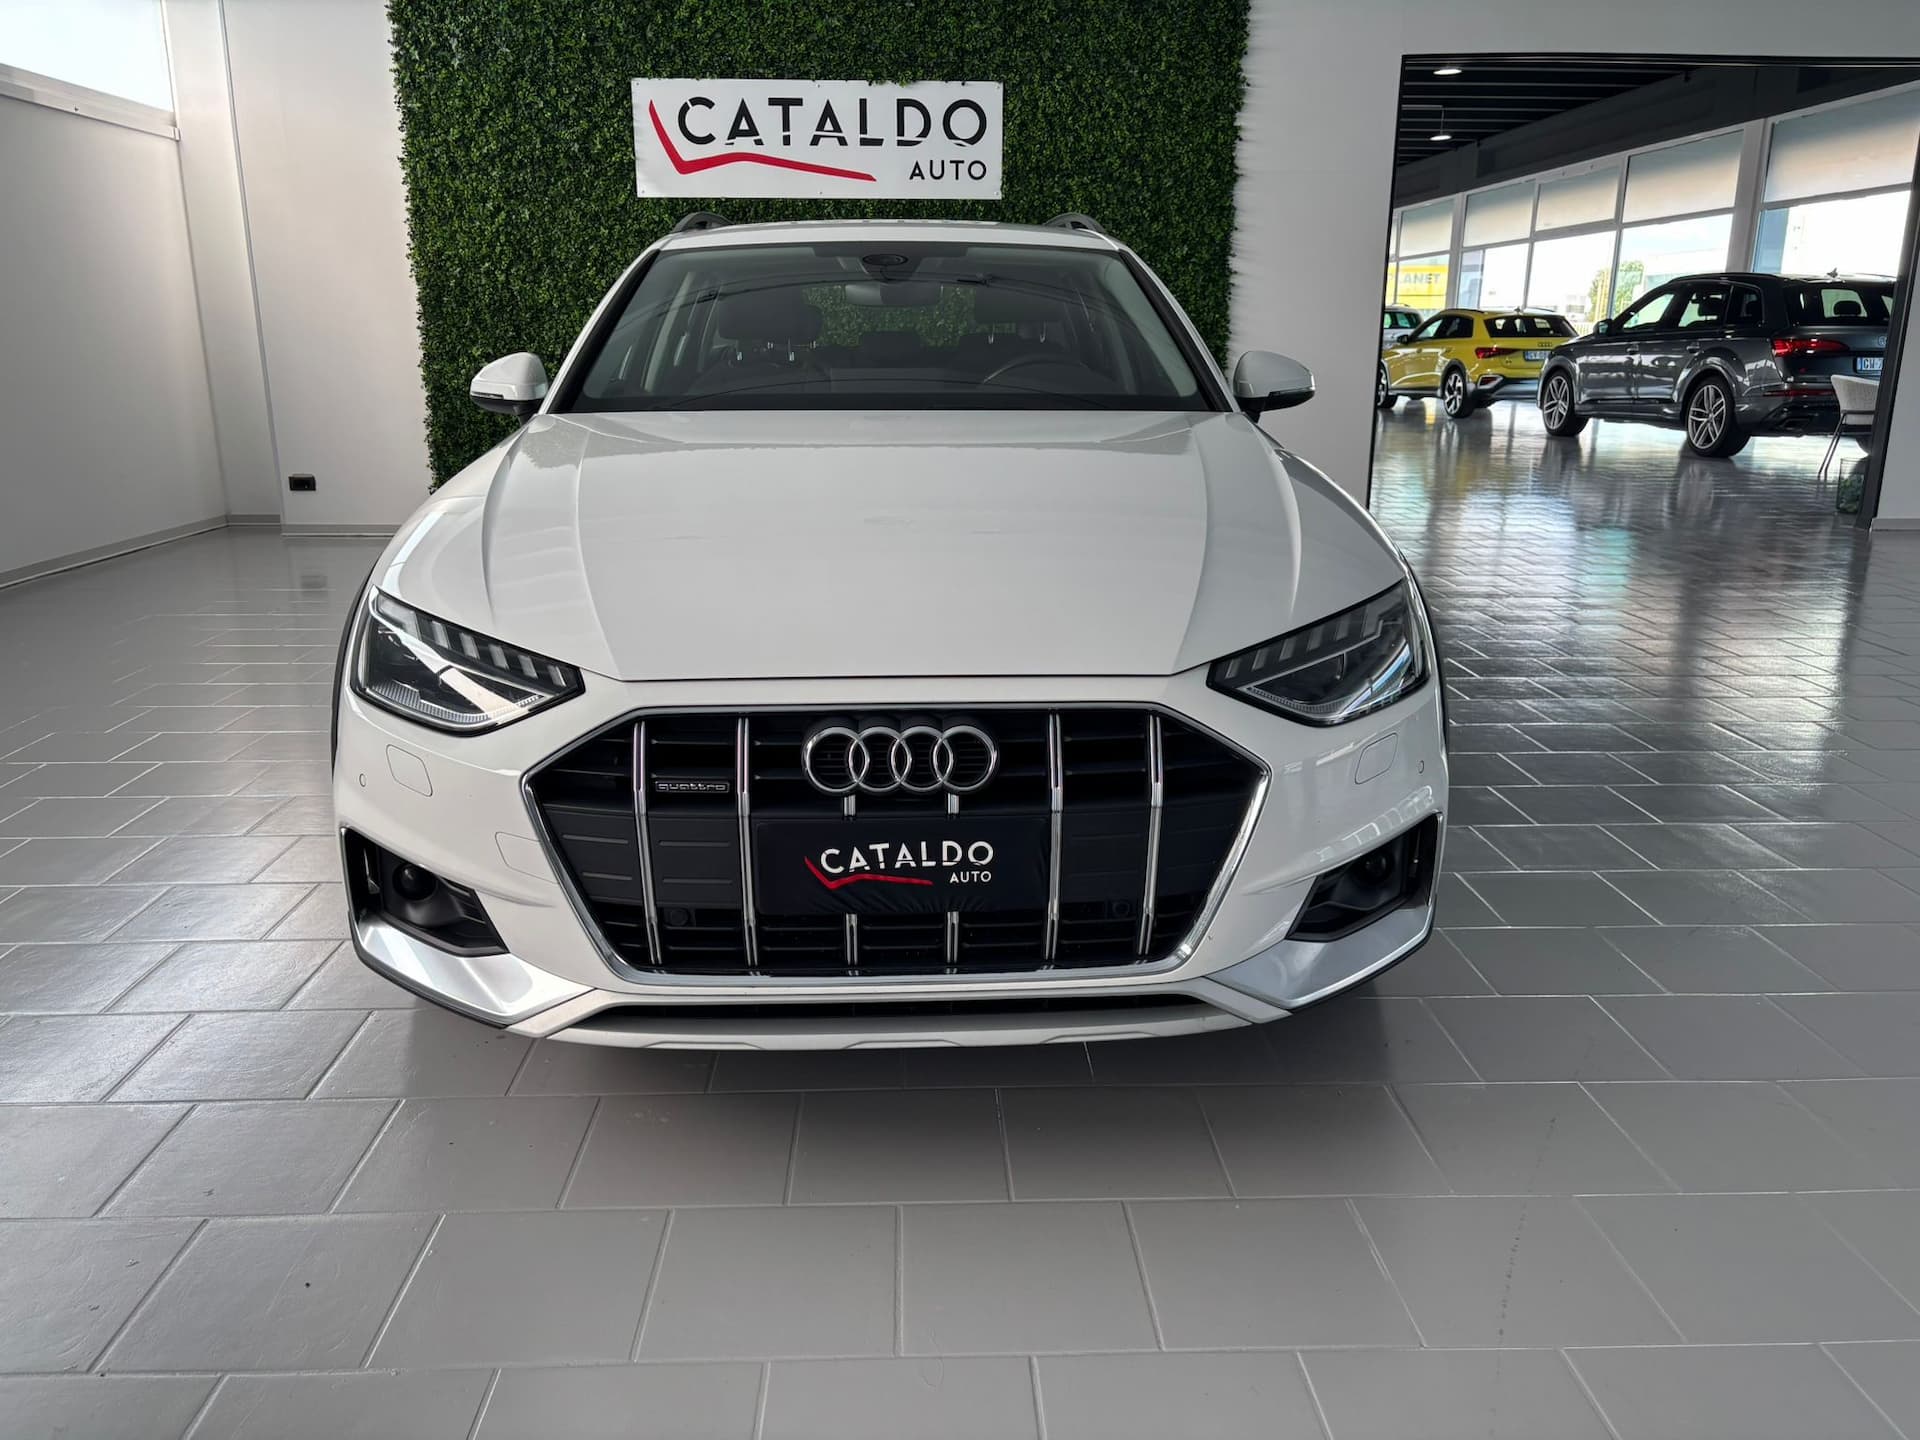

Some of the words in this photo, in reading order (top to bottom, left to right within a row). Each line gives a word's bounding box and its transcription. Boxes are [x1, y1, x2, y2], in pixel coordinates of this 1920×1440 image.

[677, 96, 988, 147] CATALDO
[909, 159, 987, 181] AUTO
[658, 783, 726, 791] quattro
[820, 840, 994, 874] CATALDO
[949, 870, 992, 884] AUTO
